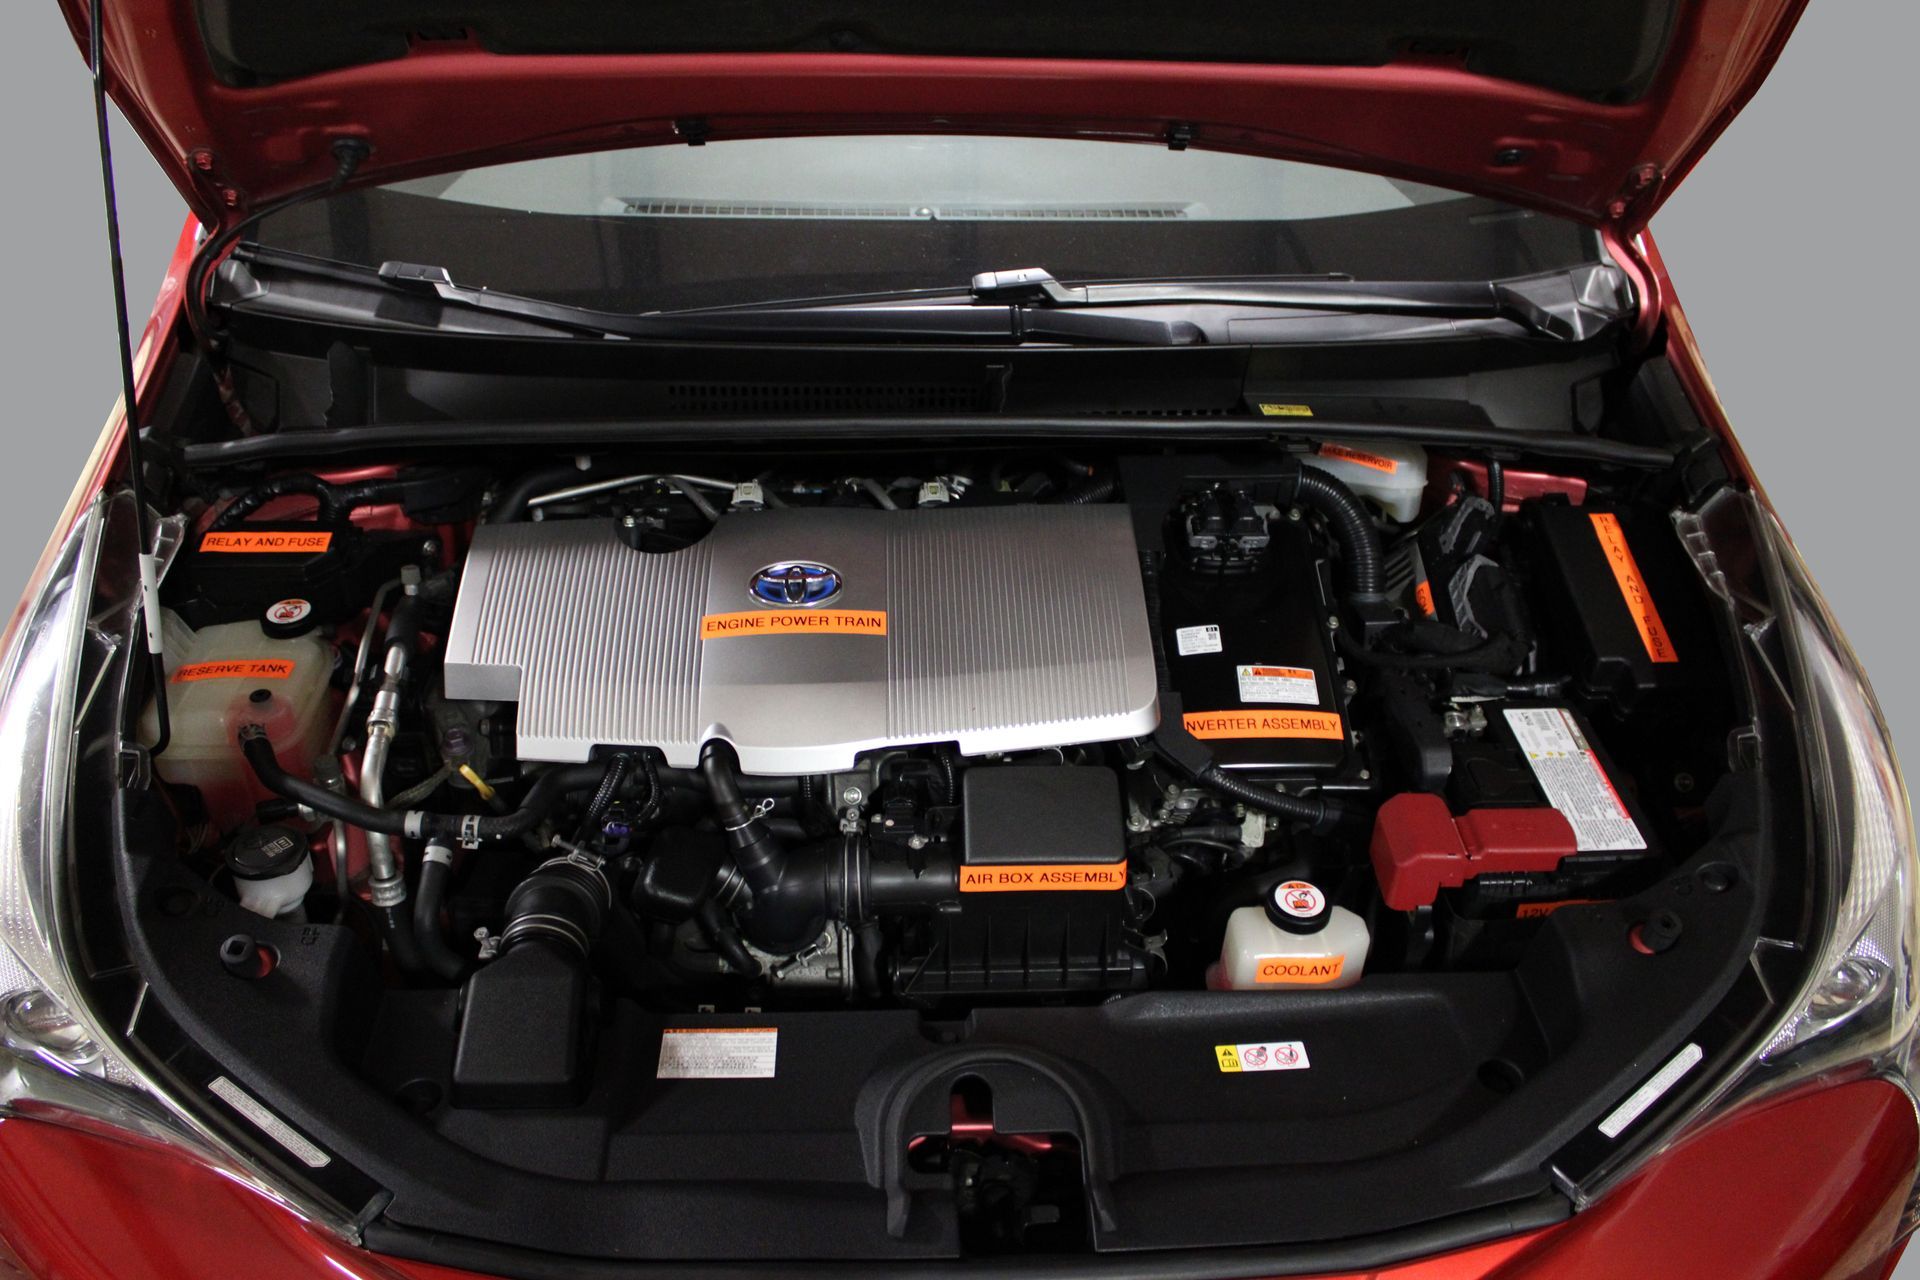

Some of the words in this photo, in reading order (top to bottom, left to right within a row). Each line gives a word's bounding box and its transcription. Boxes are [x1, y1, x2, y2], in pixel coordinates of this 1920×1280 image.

[206, 537, 252, 546] RELAY
[255, 537, 284, 546] AND
[288, 537, 326, 546] FUSE
[1599, 516, 1623, 562] RELAY
[1626, 575, 1643, 604] AND
[1643, 615, 1668, 658] FUSE
[706, 617, 765, 631] ENGINE
[770, 616, 829, 627] POWER
[834, 616, 882, 628] TRAIN
[177, 664, 246, 677] RESERVE
[250, 663, 287, 673] TANK
[1186, 718, 1256, 732] NVERTER
[1262, 718, 1338, 731] ASSEMBLY
[966, 873, 993, 884] AIR
[999, 872, 1033, 884] BOX
[1039, 871, 1125, 883] ASSEMBLY
[1263, 963, 1341, 976] COOLANT
